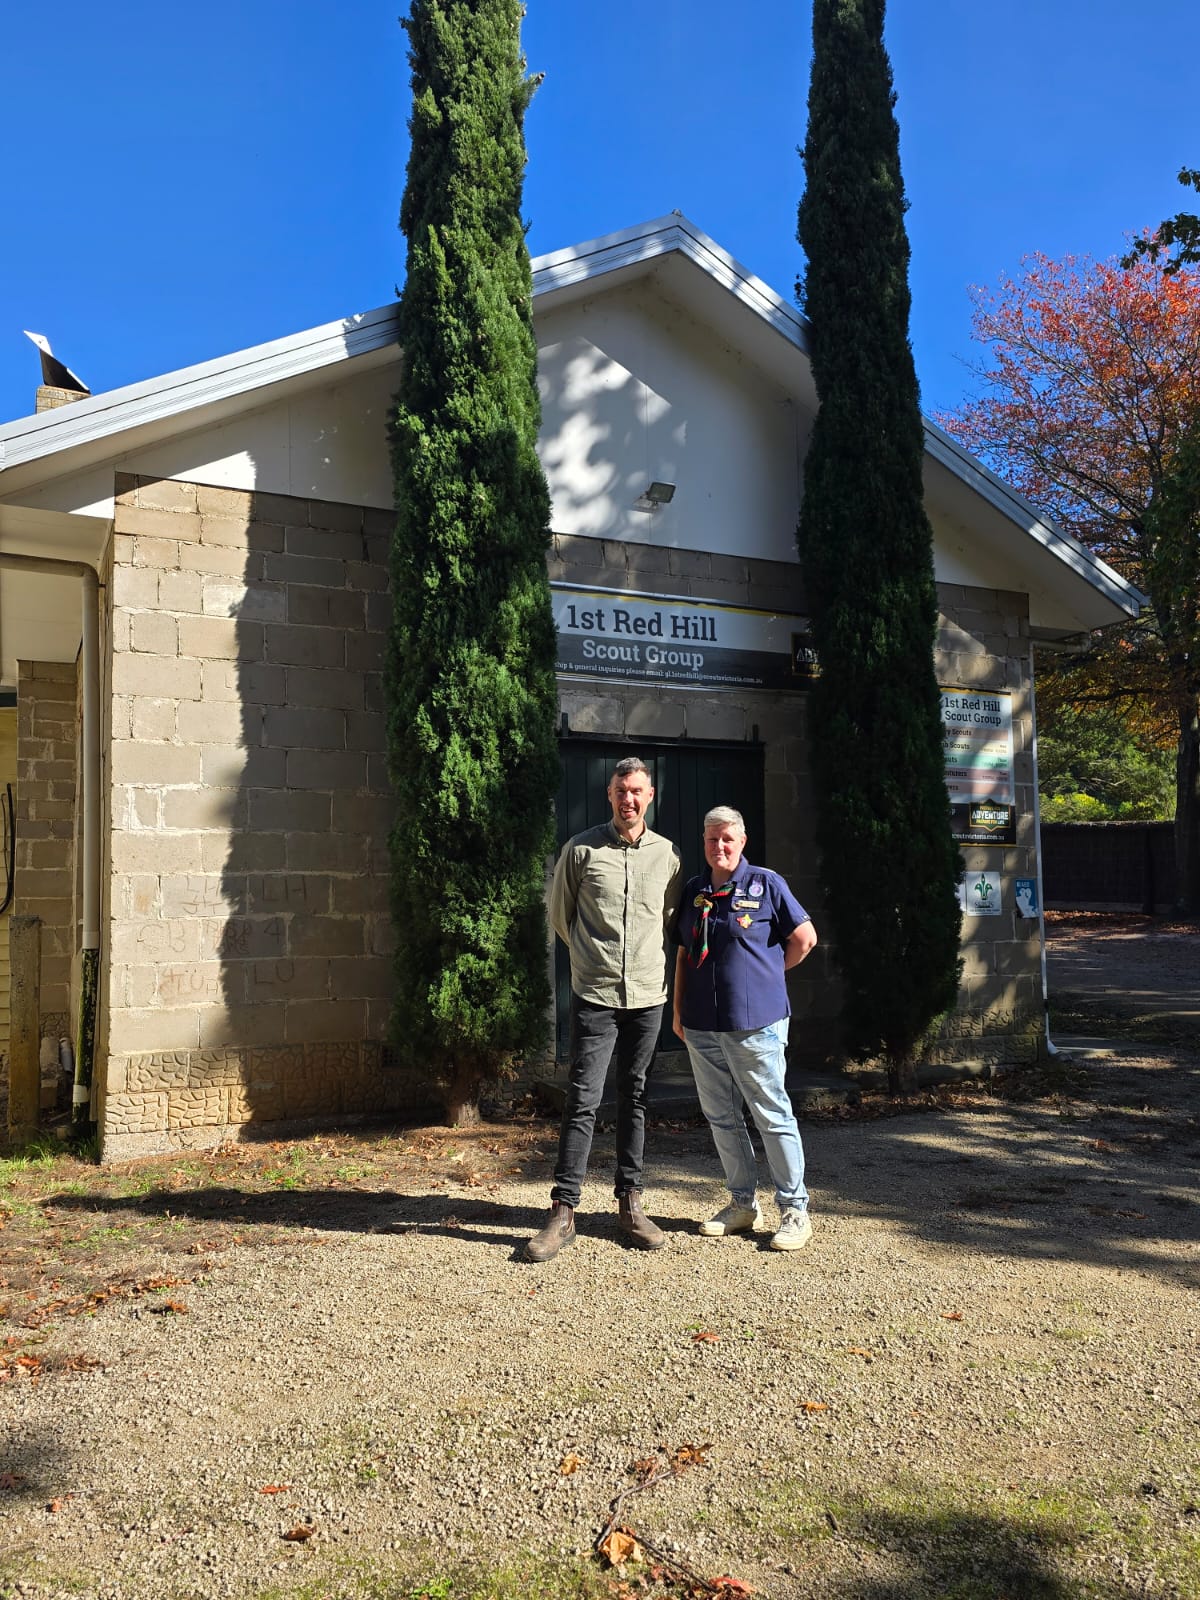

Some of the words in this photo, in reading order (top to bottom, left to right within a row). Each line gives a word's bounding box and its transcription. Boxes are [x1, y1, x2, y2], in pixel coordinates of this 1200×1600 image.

[566, 604, 605, 632] 1st
[612, 608, 663, 637] Red
[670, 614, 717, 641] Hill
[582, 639, 641, 663] Scout
[645, 645, 704, 670] Group
[574, 663, 598, 672] general
[598, 665, 625, 674] inquiries
[626, 667, 645, 675] please
[944, 697, 959, 708] 1st
[961, 698, 980, 710] Red
[983, 701, 1001, 712] Hill
[945, 711, 972, 721] Scout
[974, 713, 1002, 726] Group
[971, 810, 1009, 820] ADVENTURE
